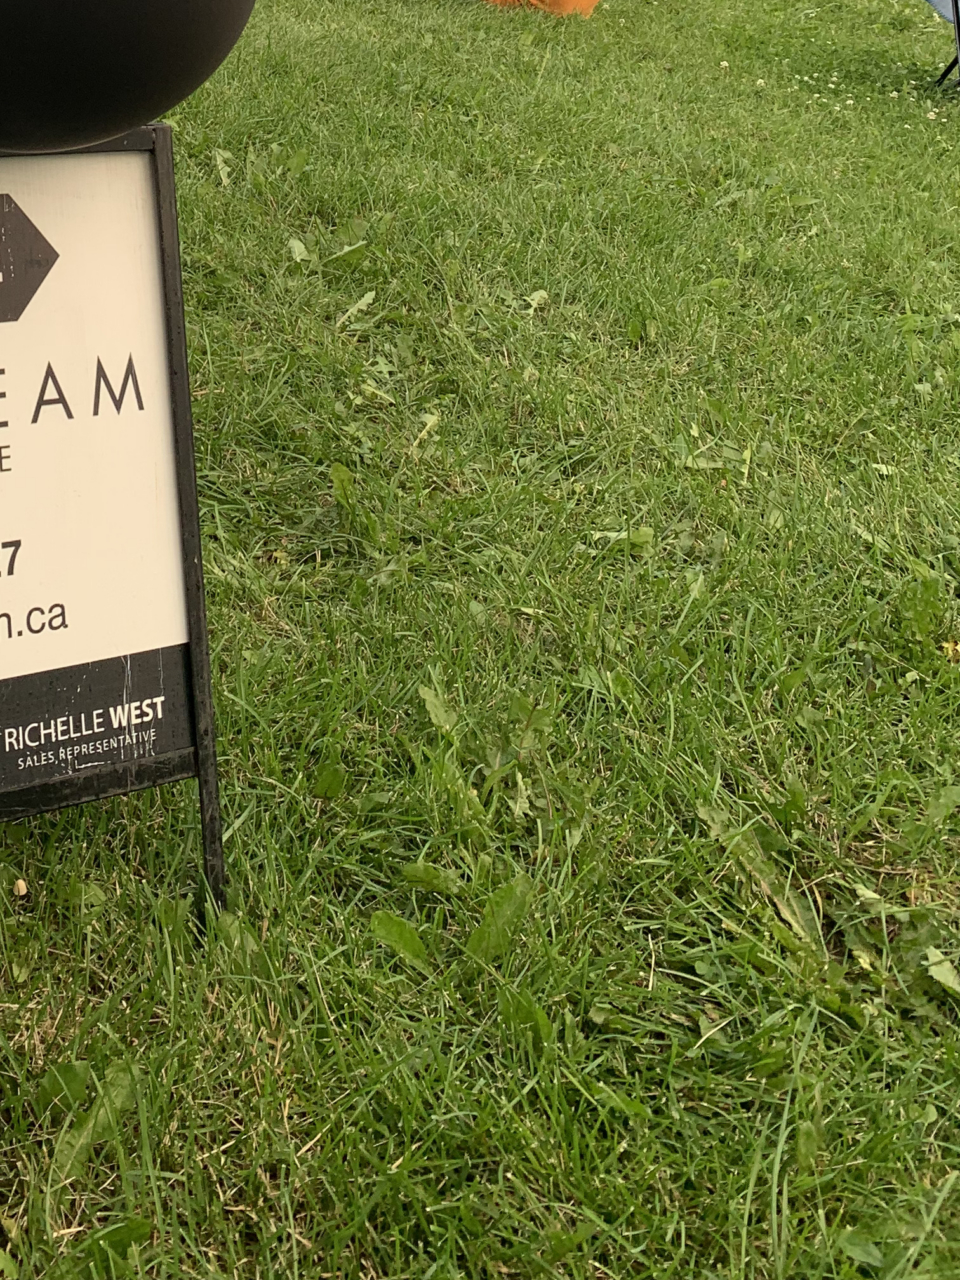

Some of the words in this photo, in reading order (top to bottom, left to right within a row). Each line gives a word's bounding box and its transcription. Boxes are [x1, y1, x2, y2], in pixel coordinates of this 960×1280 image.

[4, 709, 105, 752] RICHELLE
[109, 696, 165, 729] WEST
[59, 729, 157, 759] REPRESENTATIVE
